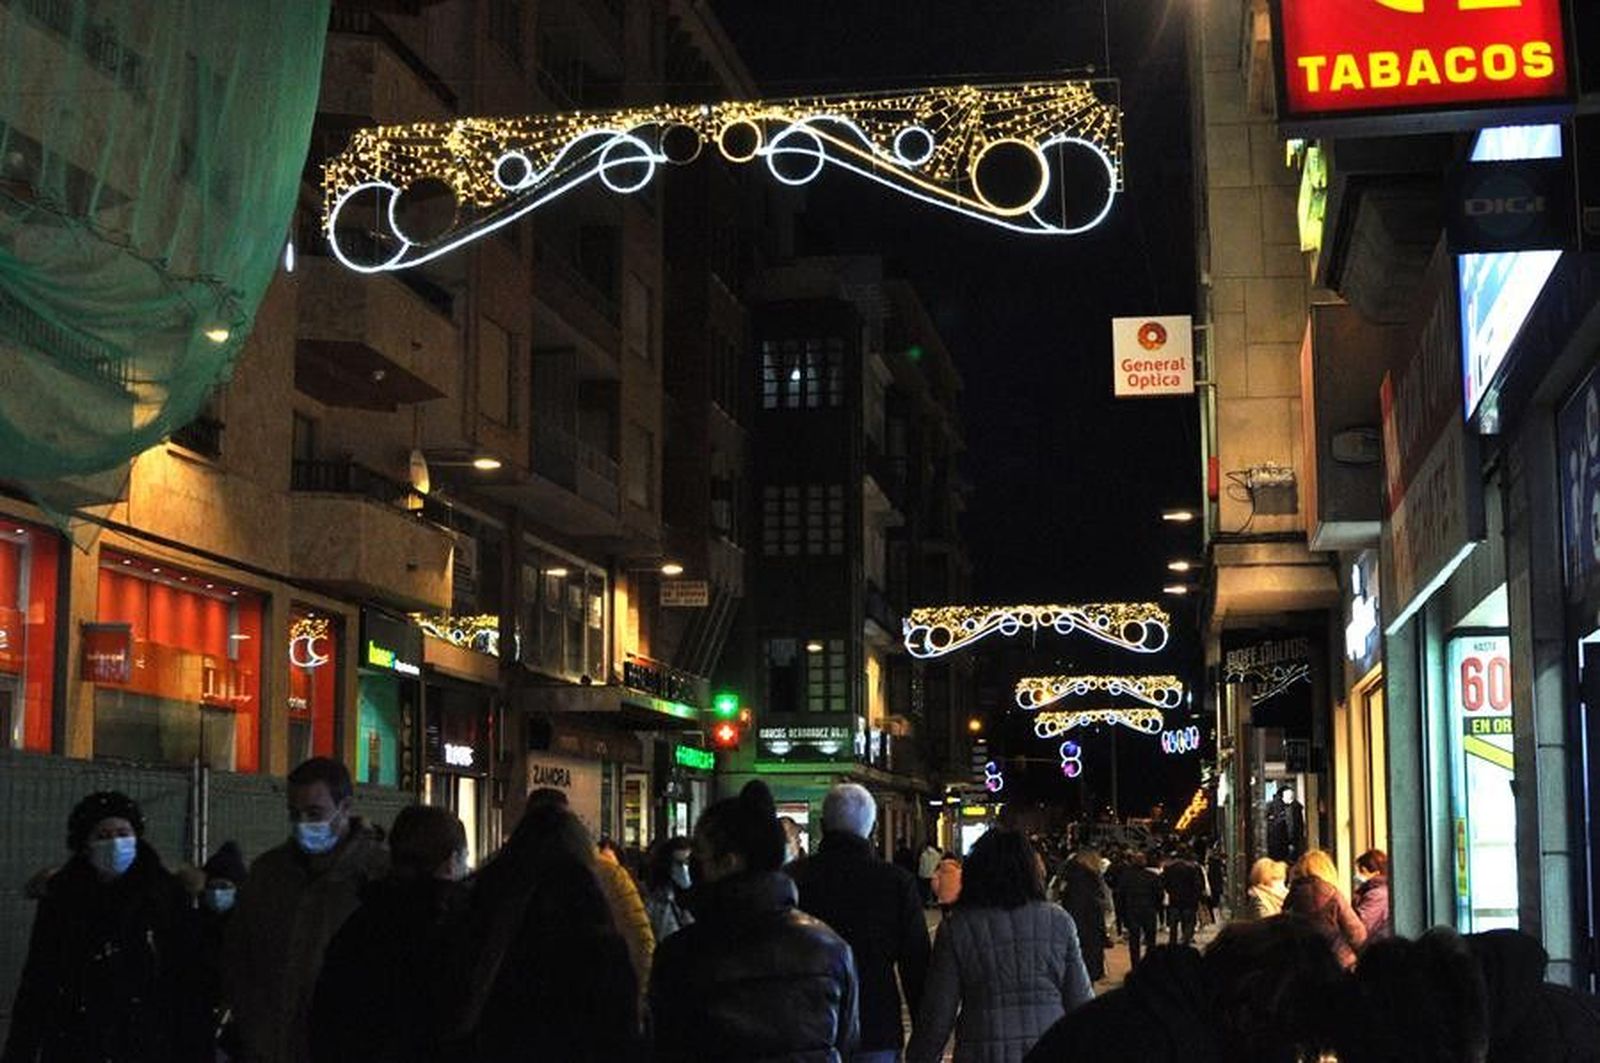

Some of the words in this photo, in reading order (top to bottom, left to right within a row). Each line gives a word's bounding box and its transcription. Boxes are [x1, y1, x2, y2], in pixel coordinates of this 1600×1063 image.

[1297, 41, 1555, 93] TABACOS
[1464, 195, 1546, 217] DIGI
[1121, 357, 1186, 372] General
[1127, 373, 1180, 390] Optica
[1461, 656, 1511, 711] 60
[1471, 718, 1490, 733] EN
[531, 763, 572, 786] ZAMORA
